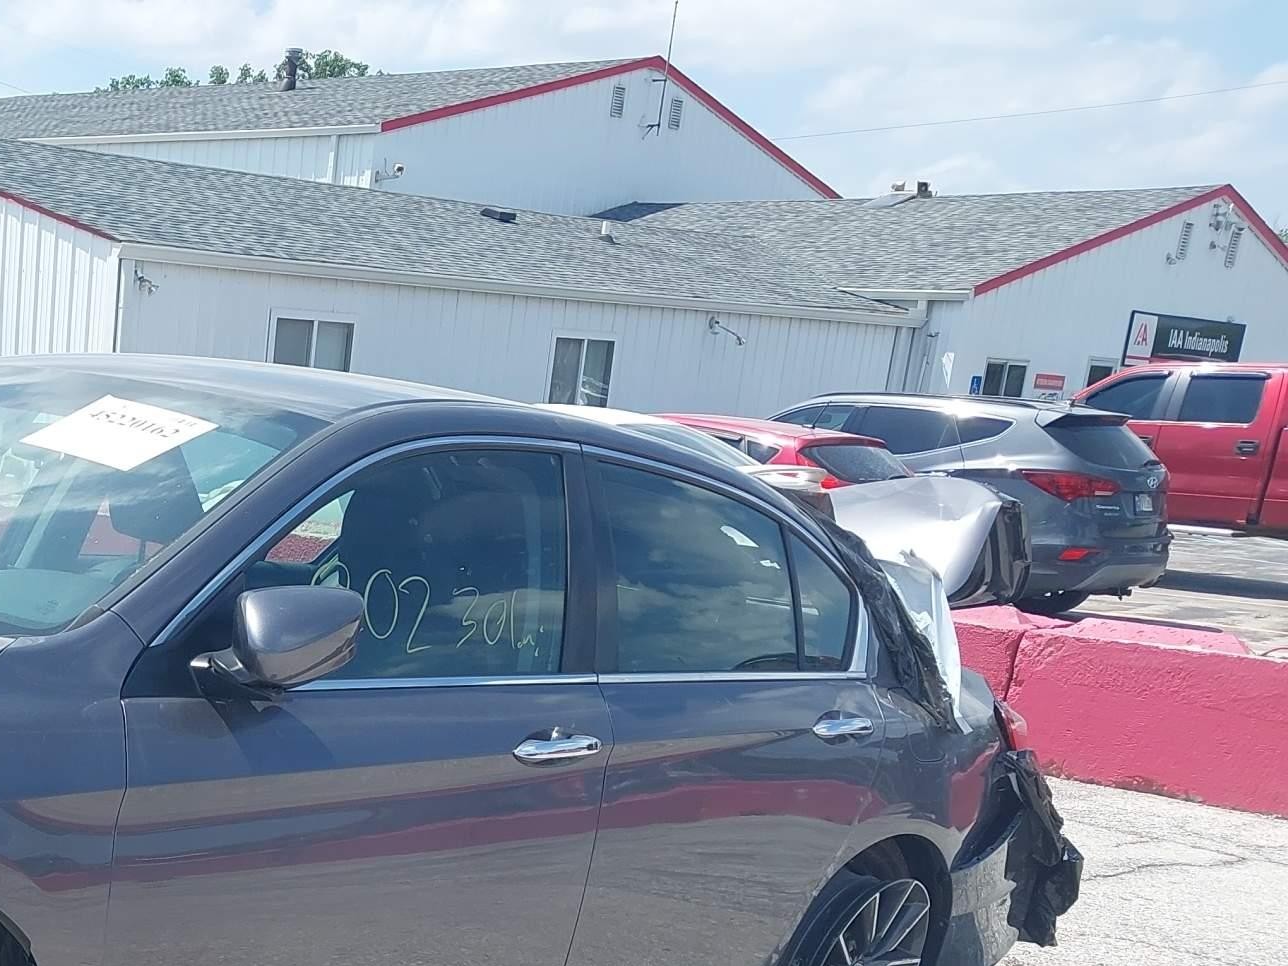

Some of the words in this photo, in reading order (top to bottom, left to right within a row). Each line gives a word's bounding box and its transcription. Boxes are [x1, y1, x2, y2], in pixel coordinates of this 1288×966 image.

[1168, 328, 1184, 349] IAA
[1184, 331, 1229, 357] Indianapolis
[90, 409, 180, 438] 45220162
